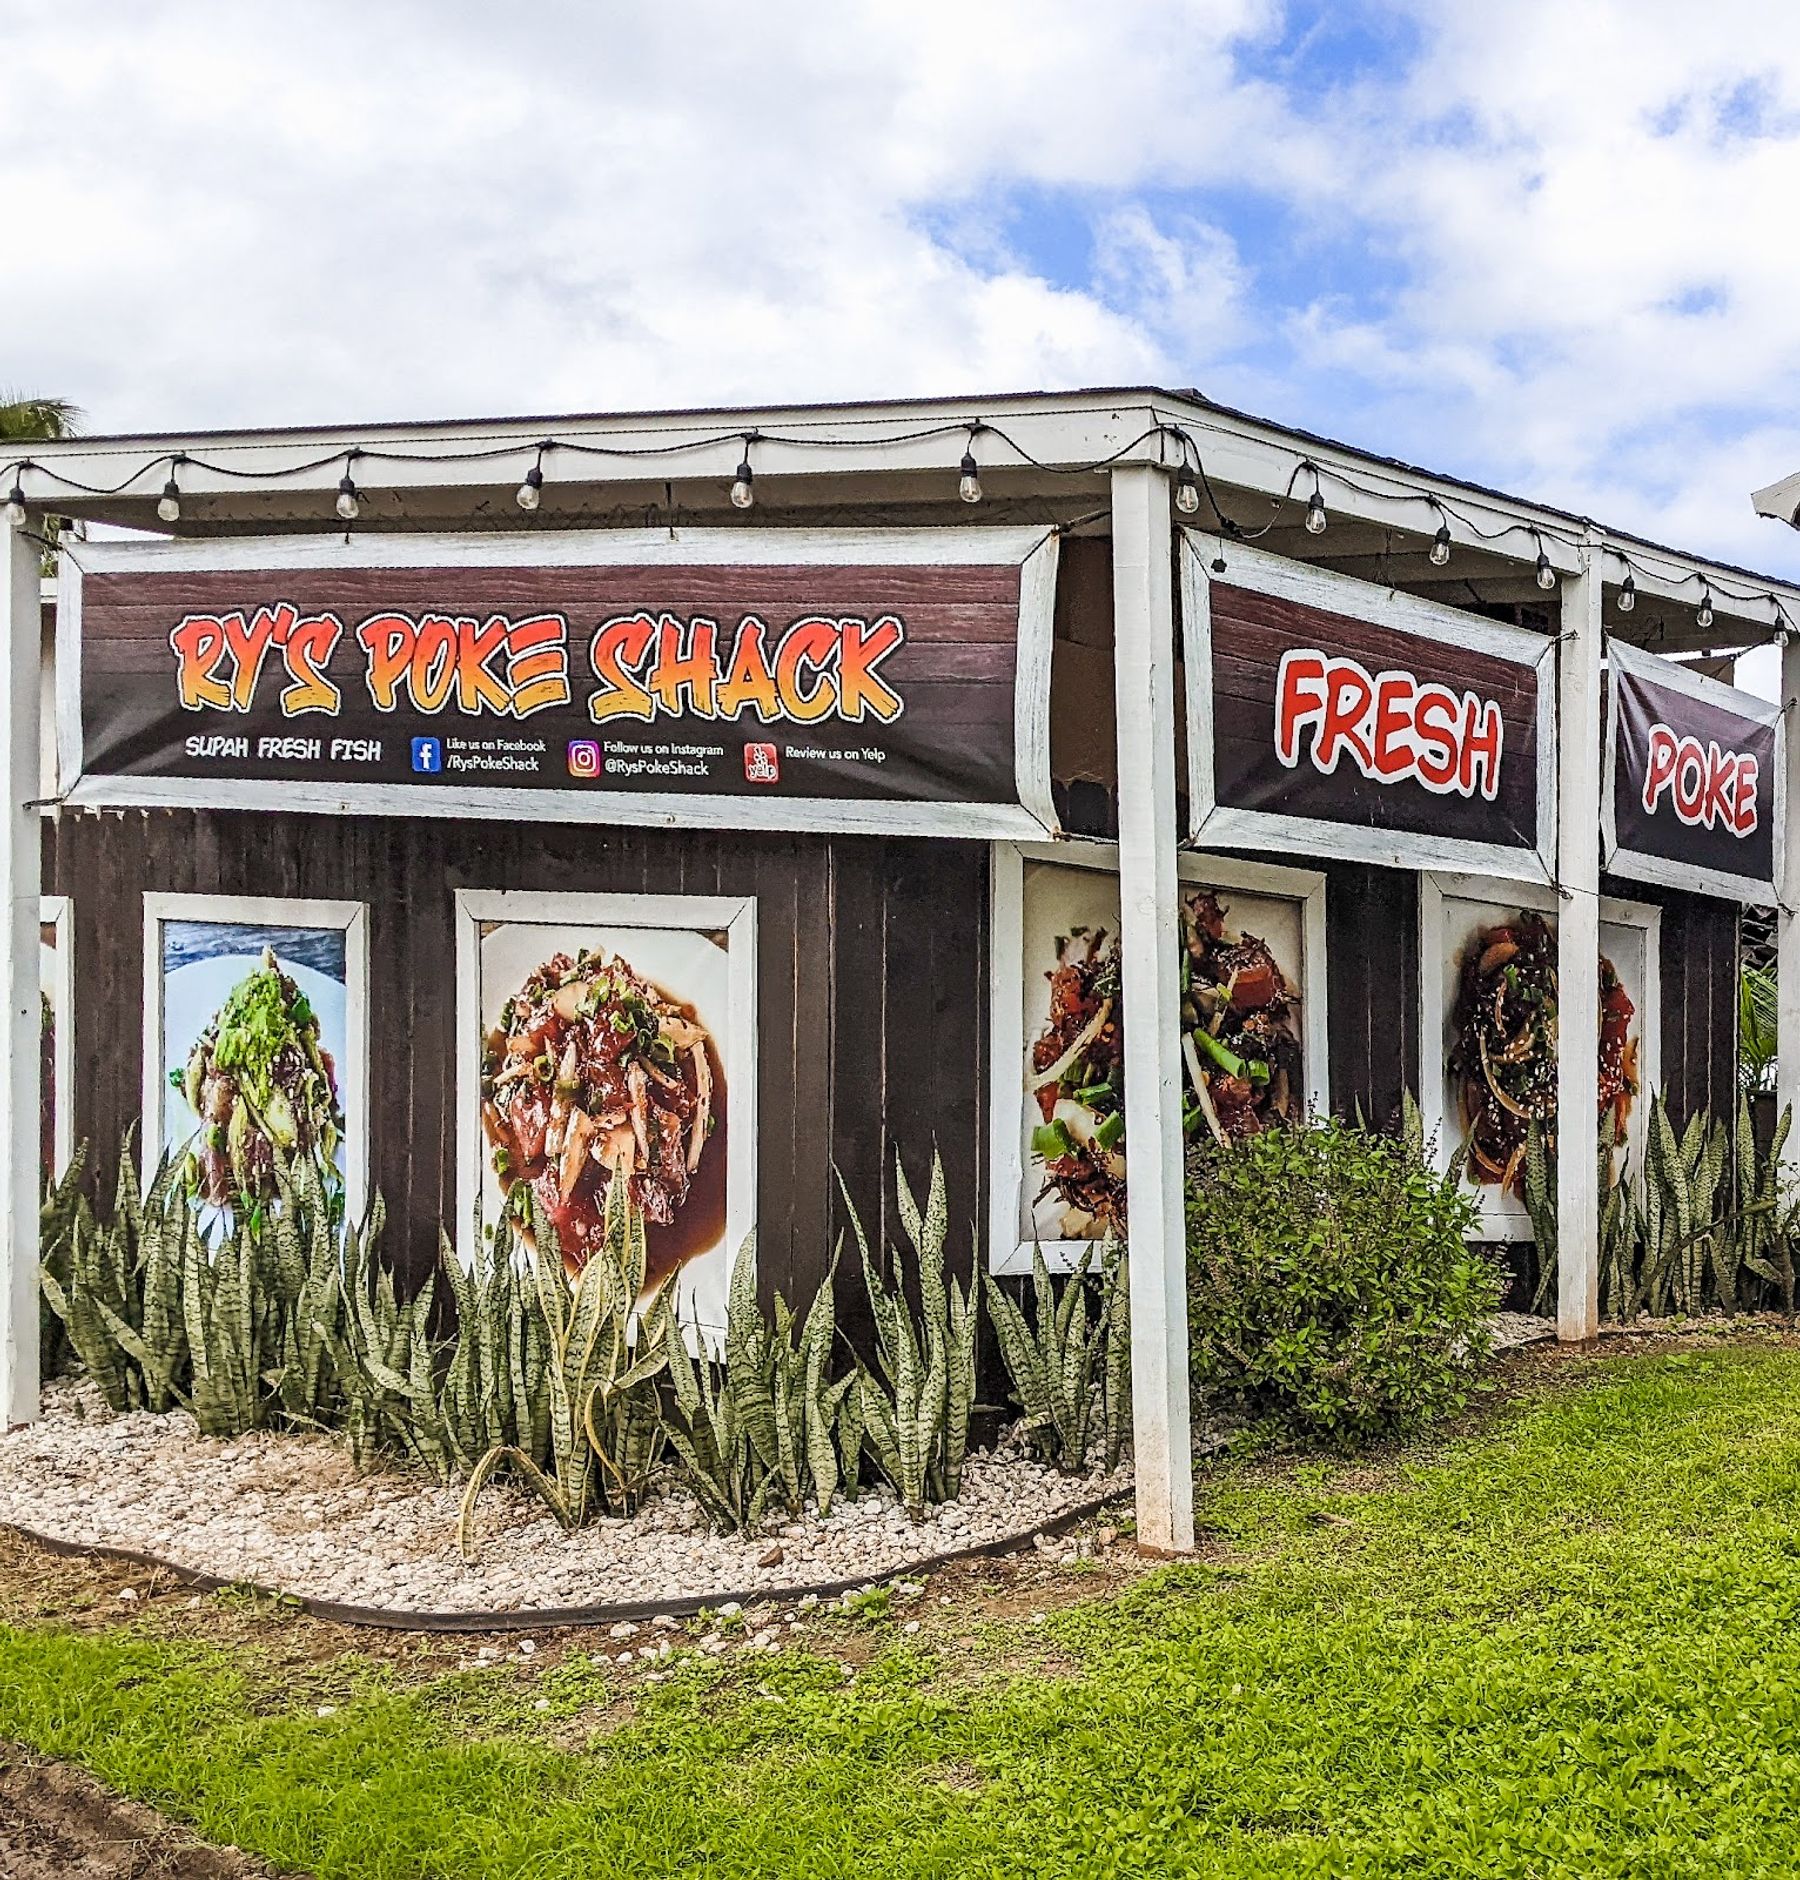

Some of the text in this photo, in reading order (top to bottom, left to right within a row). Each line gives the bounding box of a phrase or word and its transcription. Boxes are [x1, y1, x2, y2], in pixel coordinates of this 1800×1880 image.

[170, 603, 904, 724] RY'S POKE SHACK
[1274, 648, 1503, 801] FRESH
[185, 736, 381, 762] SUPAH FRESH FISH
[446, 738, 546, 752] Like us on Facebook
[604, 741, 724, 757] Follow us on Instagram
[447, 754, 540, 772] /RysPokeShack
[785, 746, 886, 763] Review us on Yelp
[605, 759, 709, 776] @RysPokeShack
[748, 765, 776, 779] yelp
[1642, 723, 1758, 838] POKE
